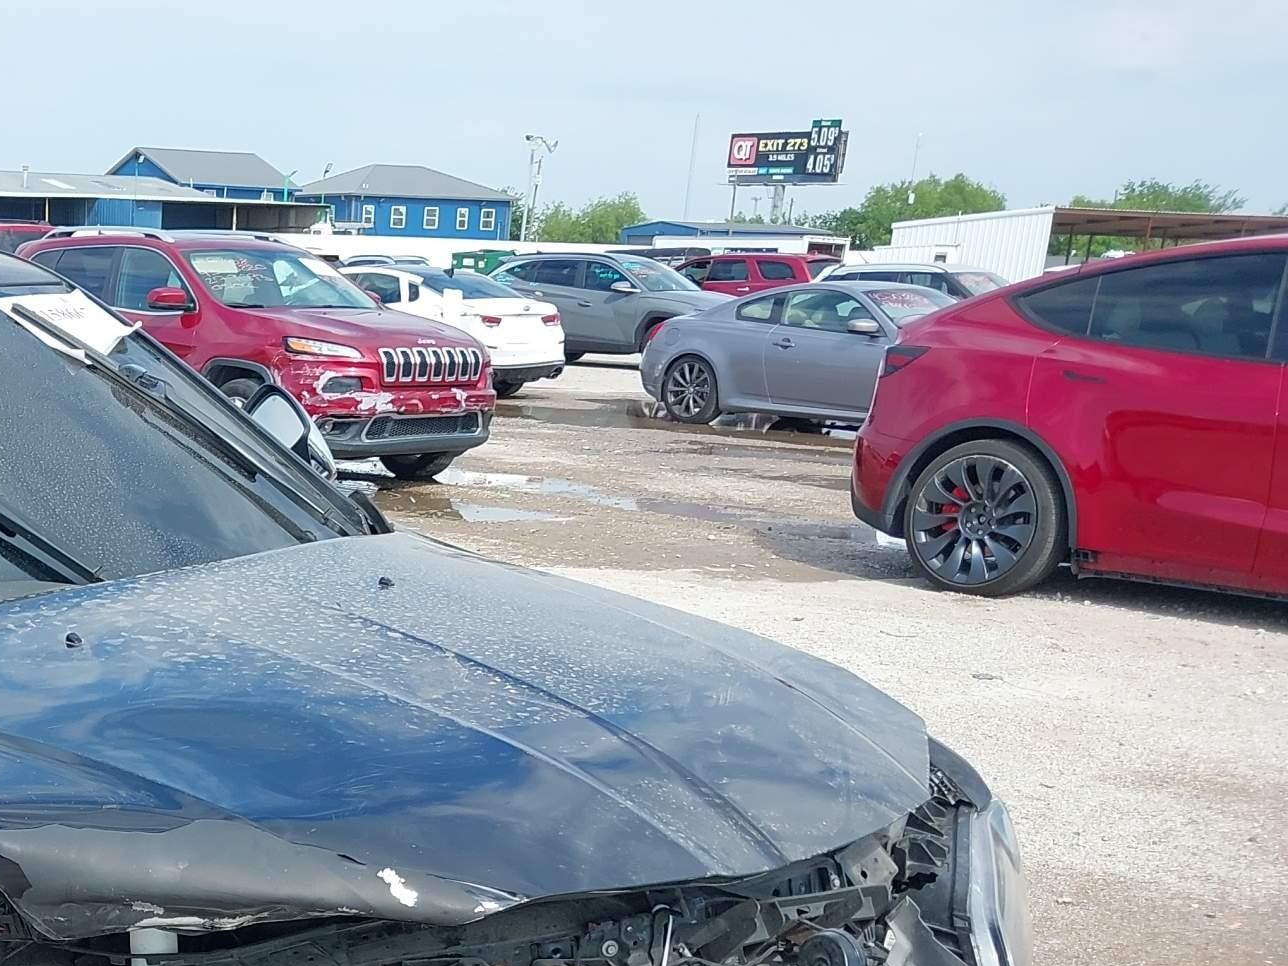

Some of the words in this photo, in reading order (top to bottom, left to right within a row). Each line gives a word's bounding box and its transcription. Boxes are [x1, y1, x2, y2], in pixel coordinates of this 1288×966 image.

[733, 140, 754, 161] QT
[758, 139, 785, 152] EXIT
[786, 138, 809, 151] 273
